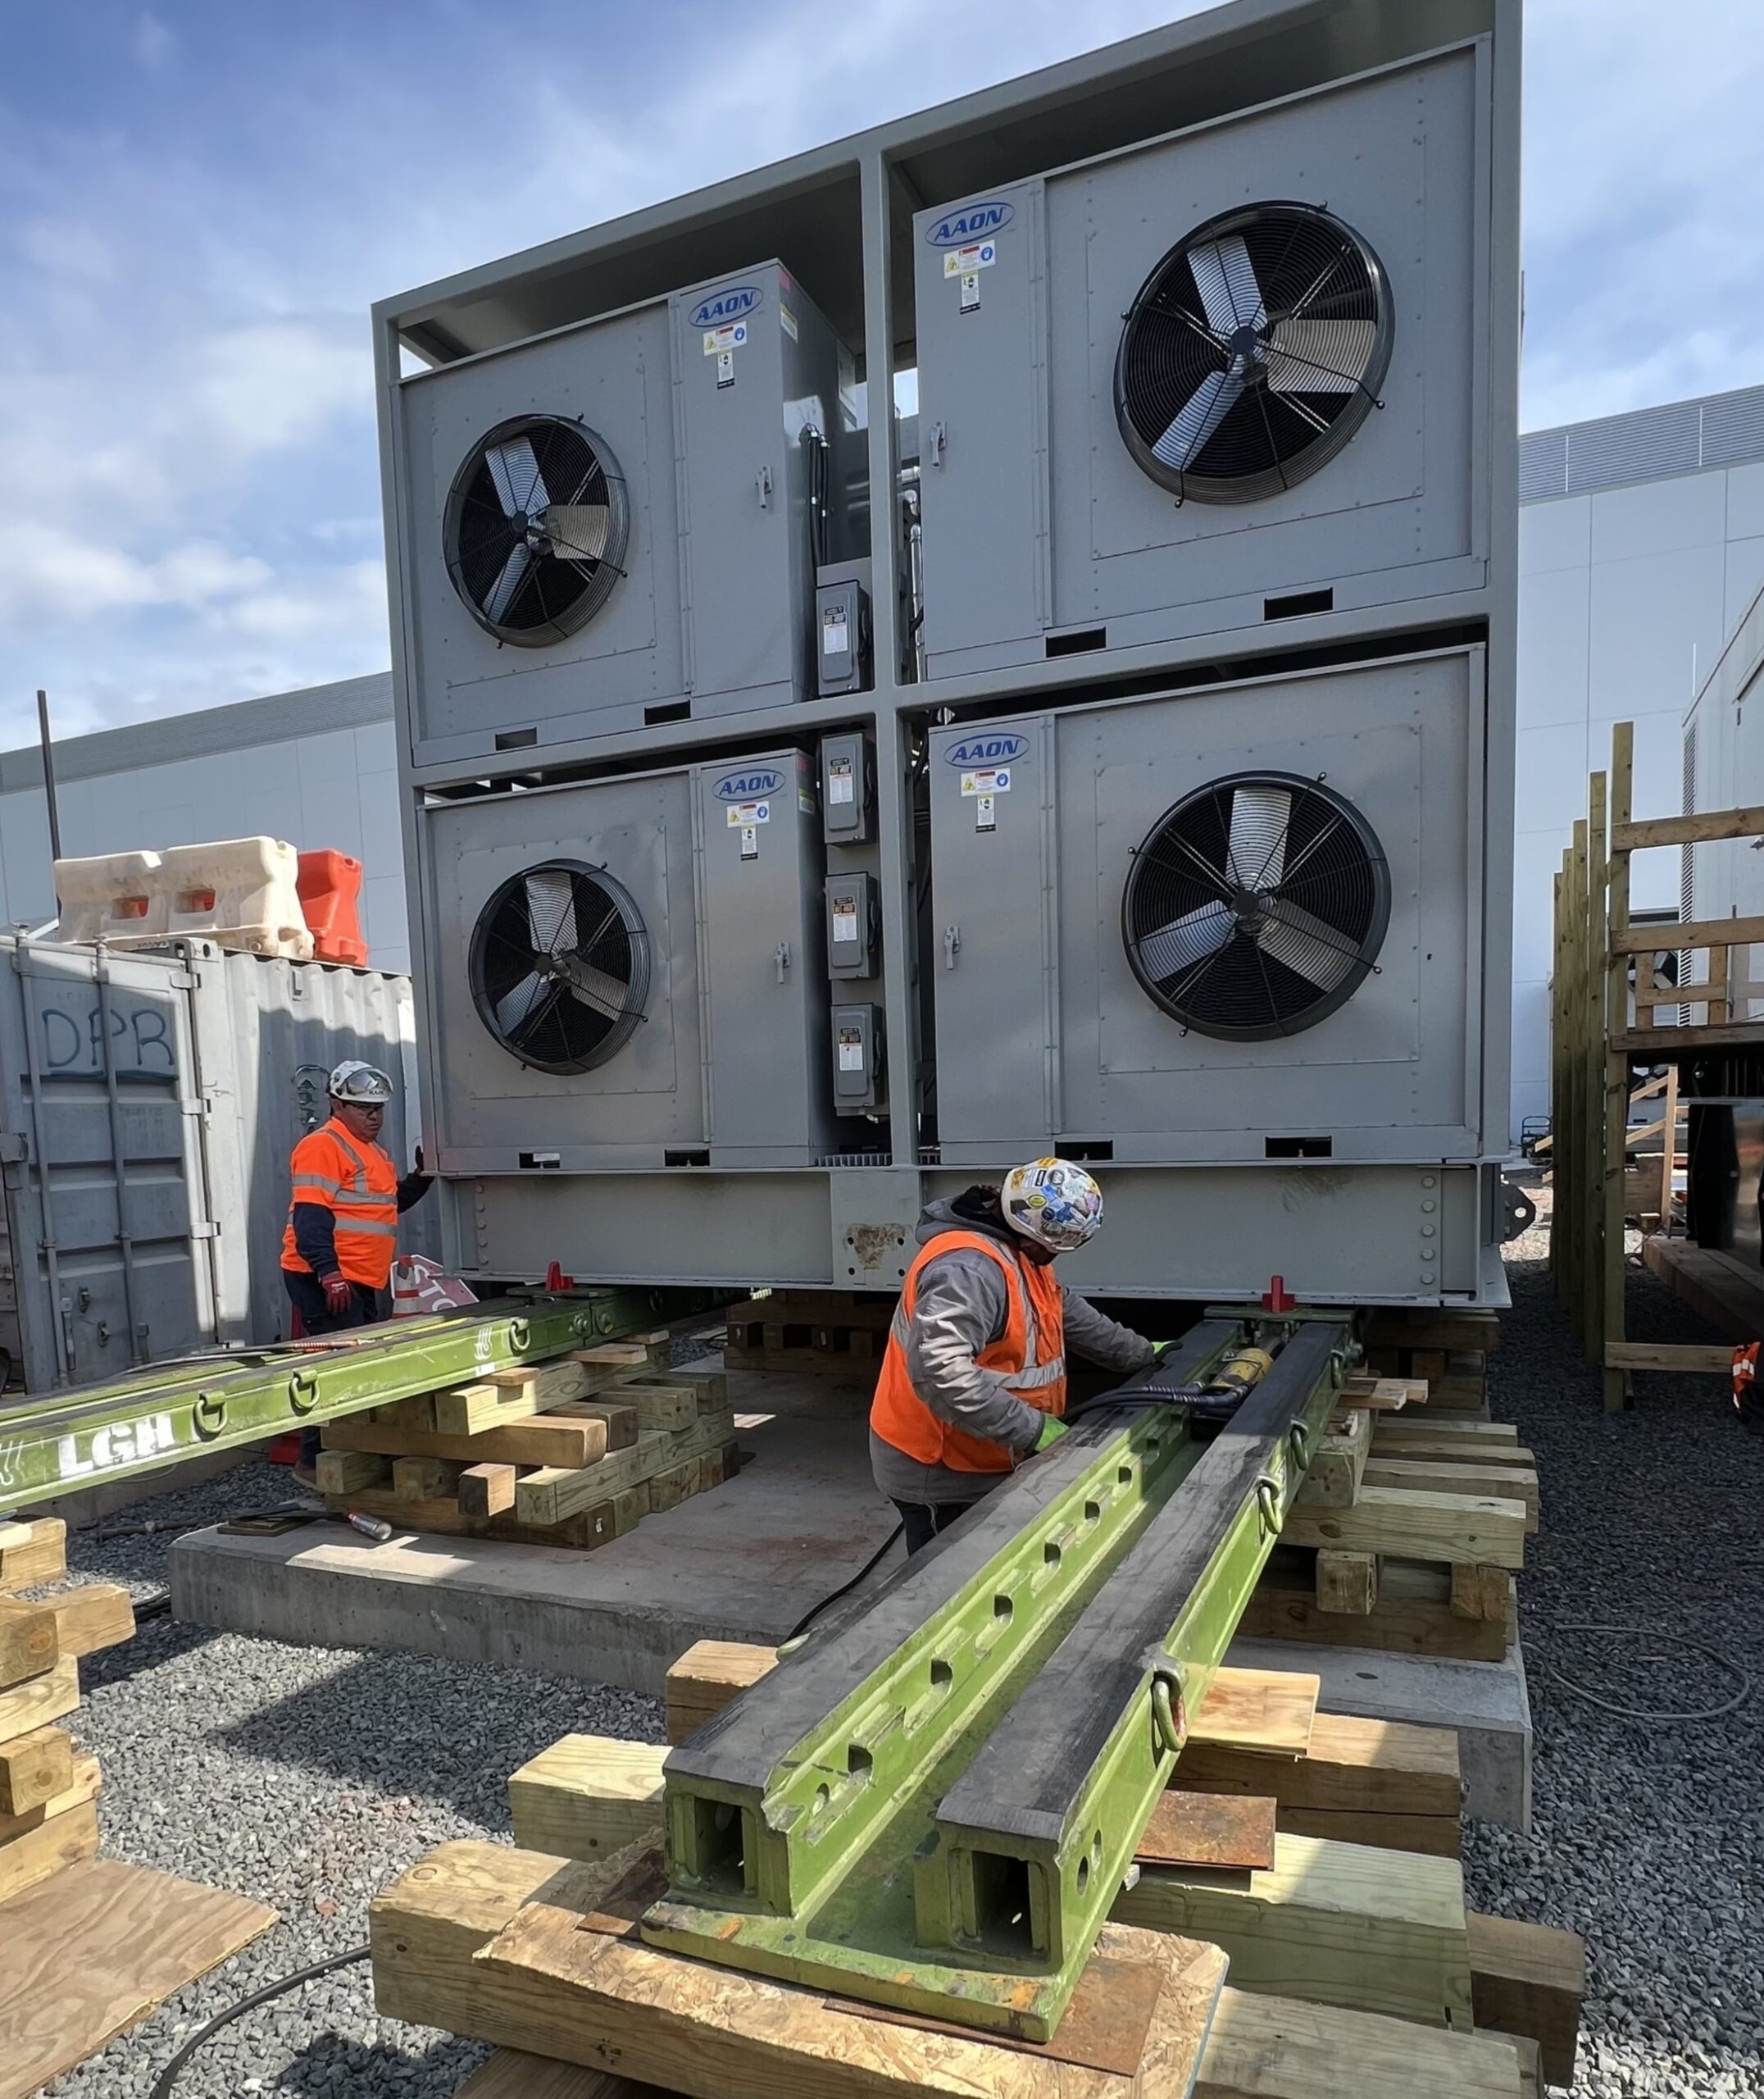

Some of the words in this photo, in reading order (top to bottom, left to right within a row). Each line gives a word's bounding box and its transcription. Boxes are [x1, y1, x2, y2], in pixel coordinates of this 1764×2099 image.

[934, 207, 1004, 241] AAON
[696, 291, 754, 323] AAON
[952, 739, 1020, 762] AAON
[719, 774, 777, 795] AAON
[42, 1008, 175, 1068] DPR
[58, 1414, 175, 1479] LGH
